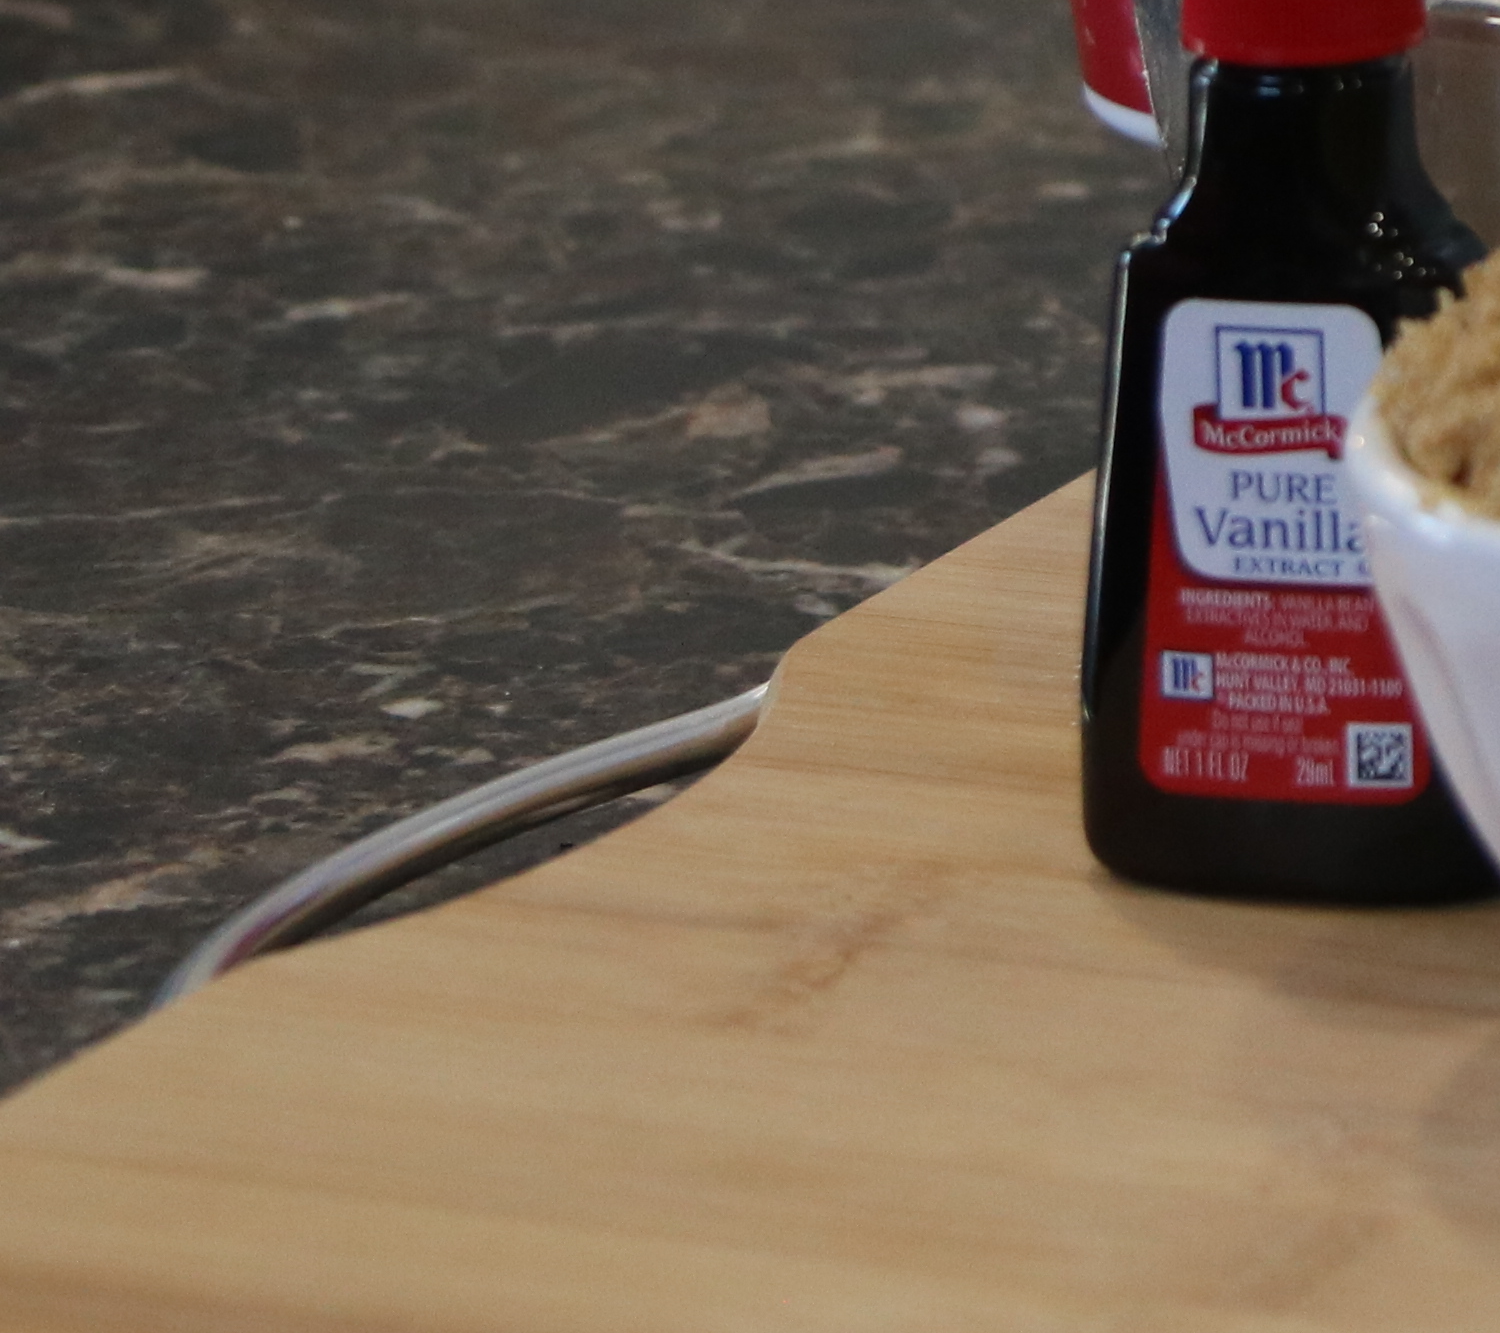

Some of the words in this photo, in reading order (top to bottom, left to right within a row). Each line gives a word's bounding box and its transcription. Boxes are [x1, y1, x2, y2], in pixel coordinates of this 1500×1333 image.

[1202, 419, 1339, 448] McCormick
[1231, 469, 1338, 506] PURE
[1194, 505, 1365, 554] Vanilla
[1234, 556, 1345, 578] EXTRACT
